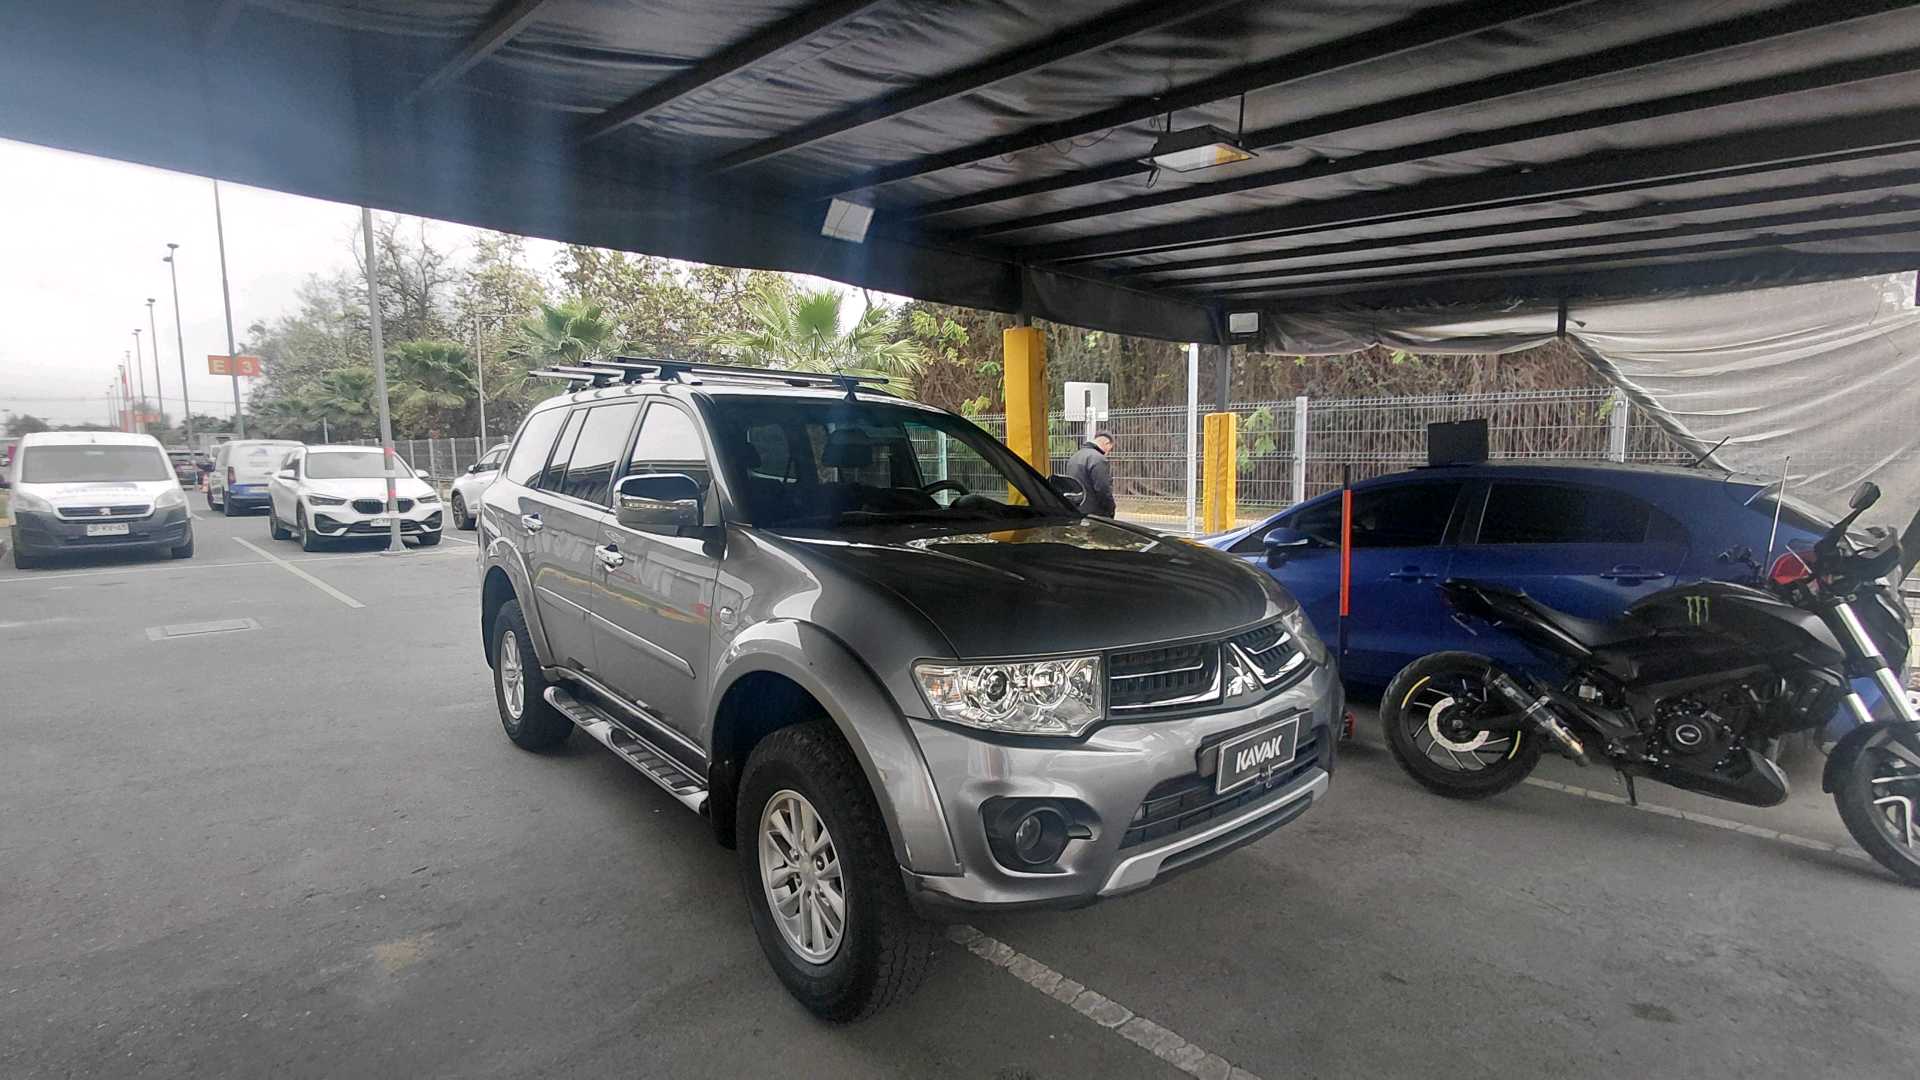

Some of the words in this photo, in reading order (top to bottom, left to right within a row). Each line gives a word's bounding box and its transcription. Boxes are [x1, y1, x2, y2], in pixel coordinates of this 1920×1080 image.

[213, 360, 224, 373] E
[241, 361, 252, 373] 3
[1236, 735, 1283, 773] KAVAK
